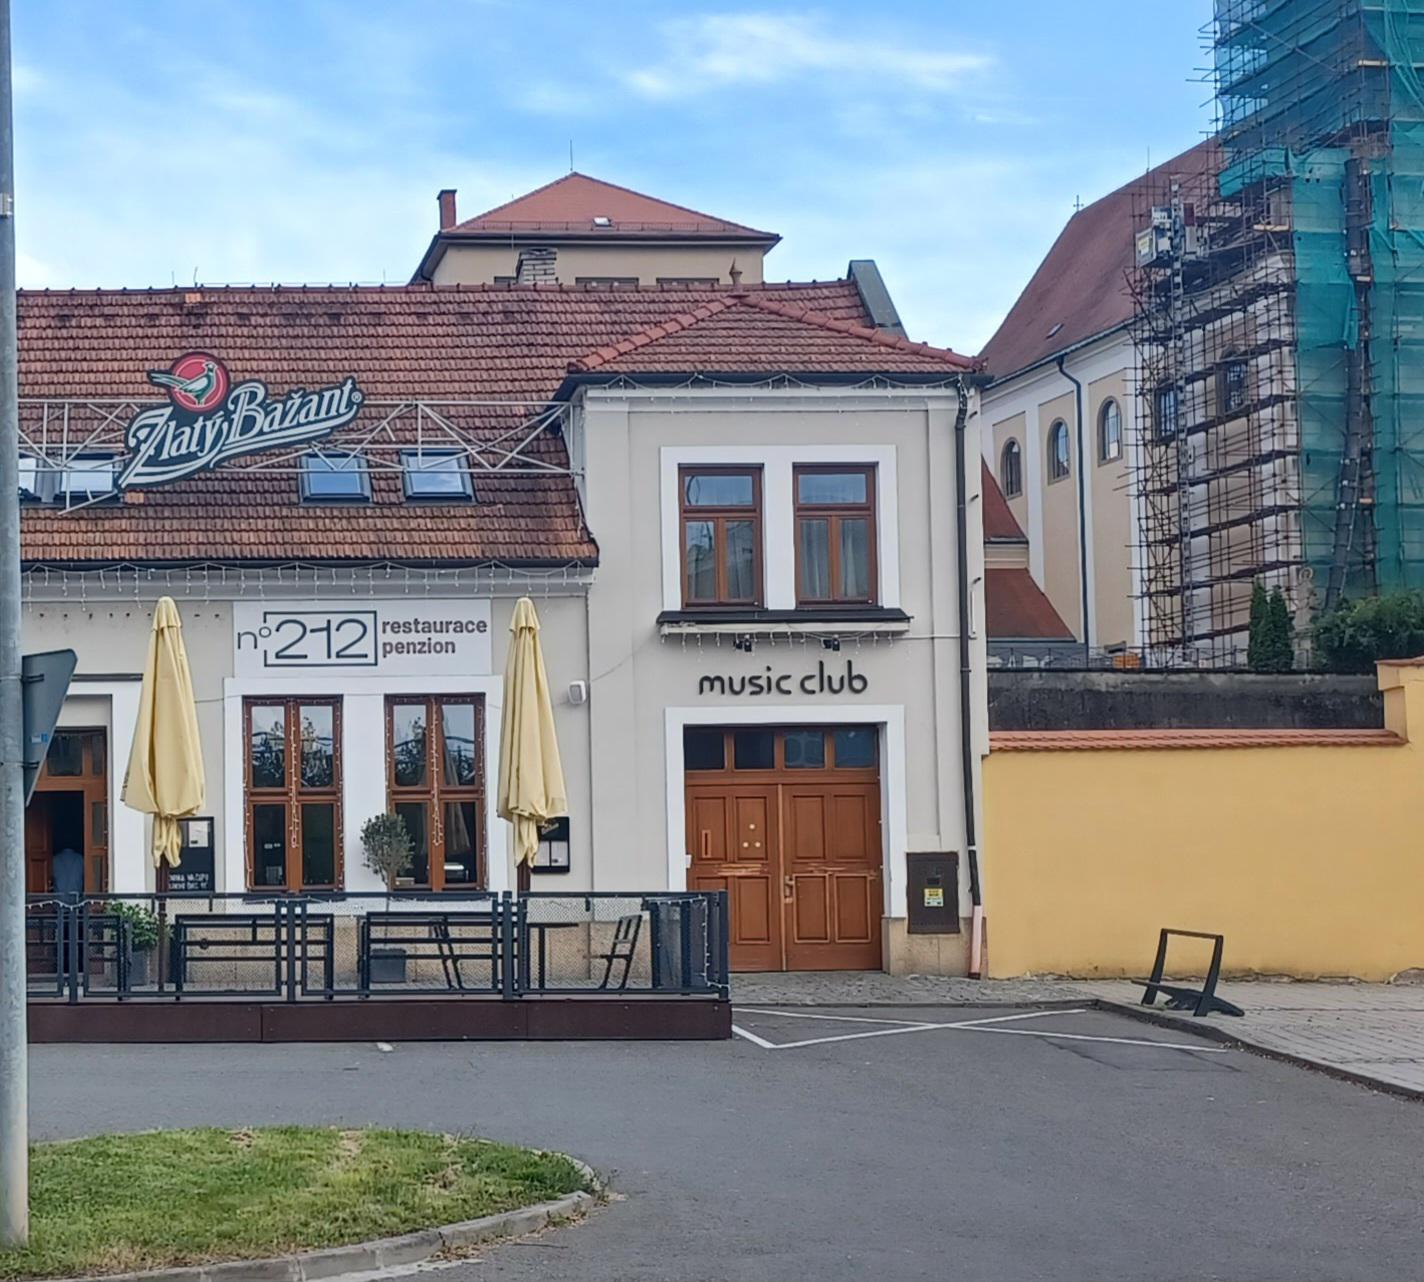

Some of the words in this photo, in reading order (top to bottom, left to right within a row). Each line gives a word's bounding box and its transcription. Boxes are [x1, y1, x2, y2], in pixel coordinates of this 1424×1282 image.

[119, 406, 229, 488] Zlatý
[224, 378, 358, 447] Bažant
[381, 618, 488, 635] restaurace
[381, 637, 457, 658] penzion
[698, 665, 792, 696] music
[799, 659, 869, 695] club
